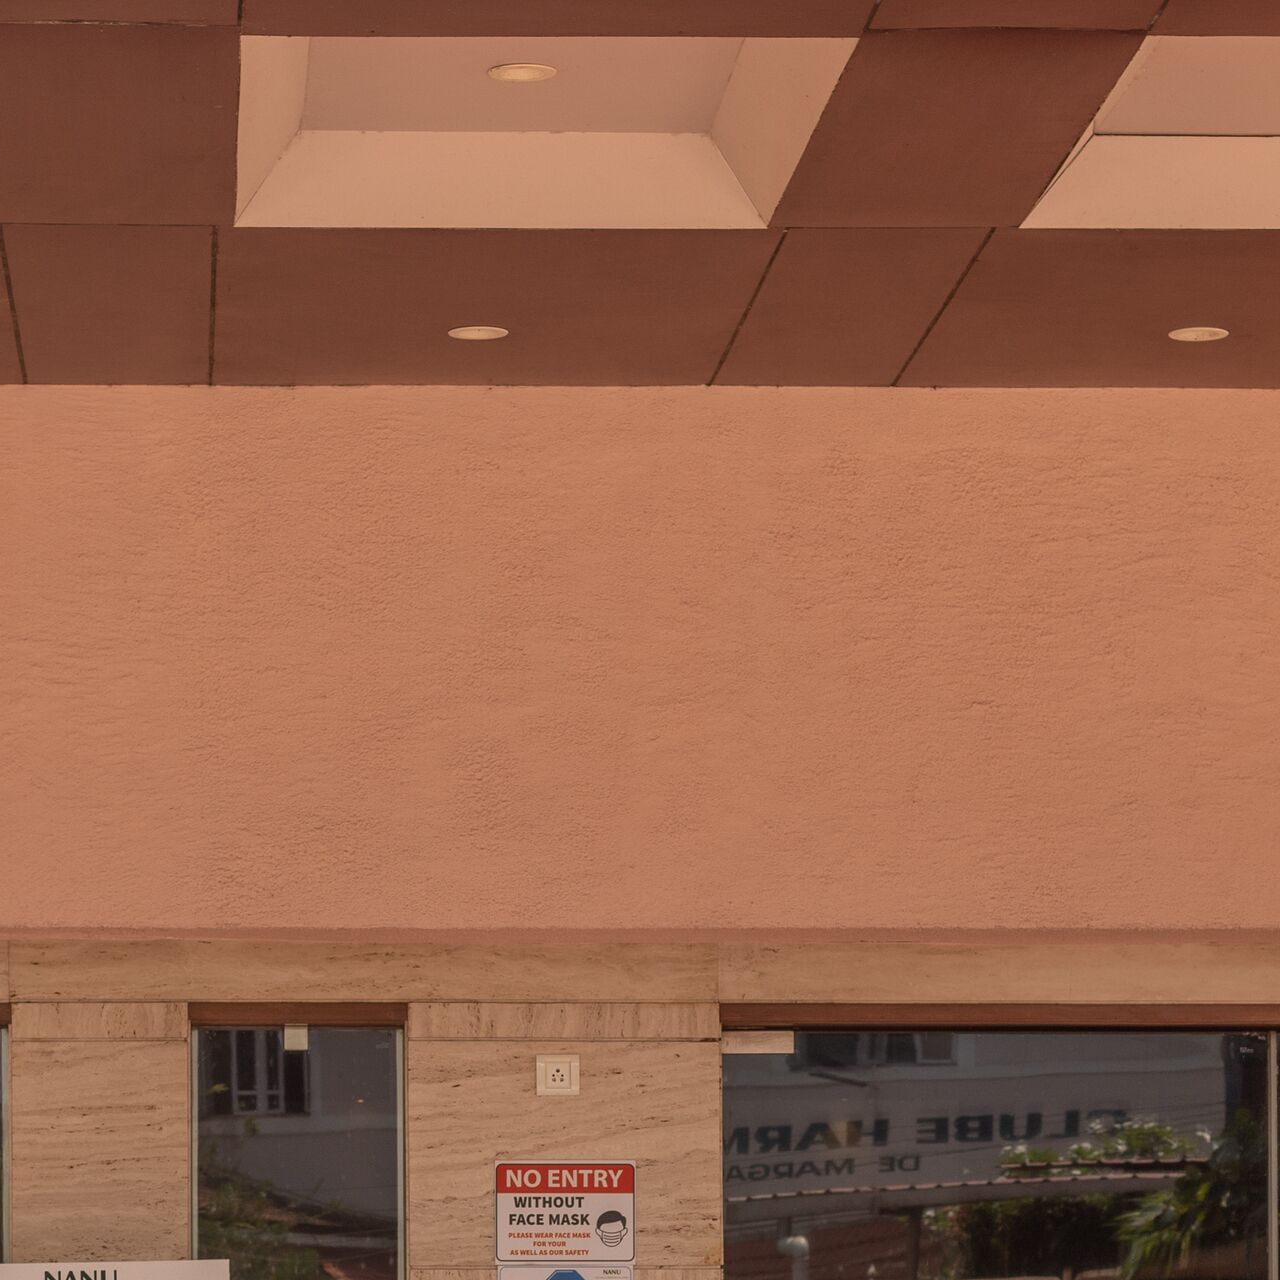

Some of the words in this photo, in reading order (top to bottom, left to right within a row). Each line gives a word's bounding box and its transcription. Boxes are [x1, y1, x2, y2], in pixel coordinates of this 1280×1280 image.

[506, 1169, 541, 1188] NO
[548, 1169, 623, 1188] ENTRY
[514, 1197, 584, 1208] WITHOUT
[509, 1214, 544, 1225] FACE
[549, 1214, 590, 1225] MASK
